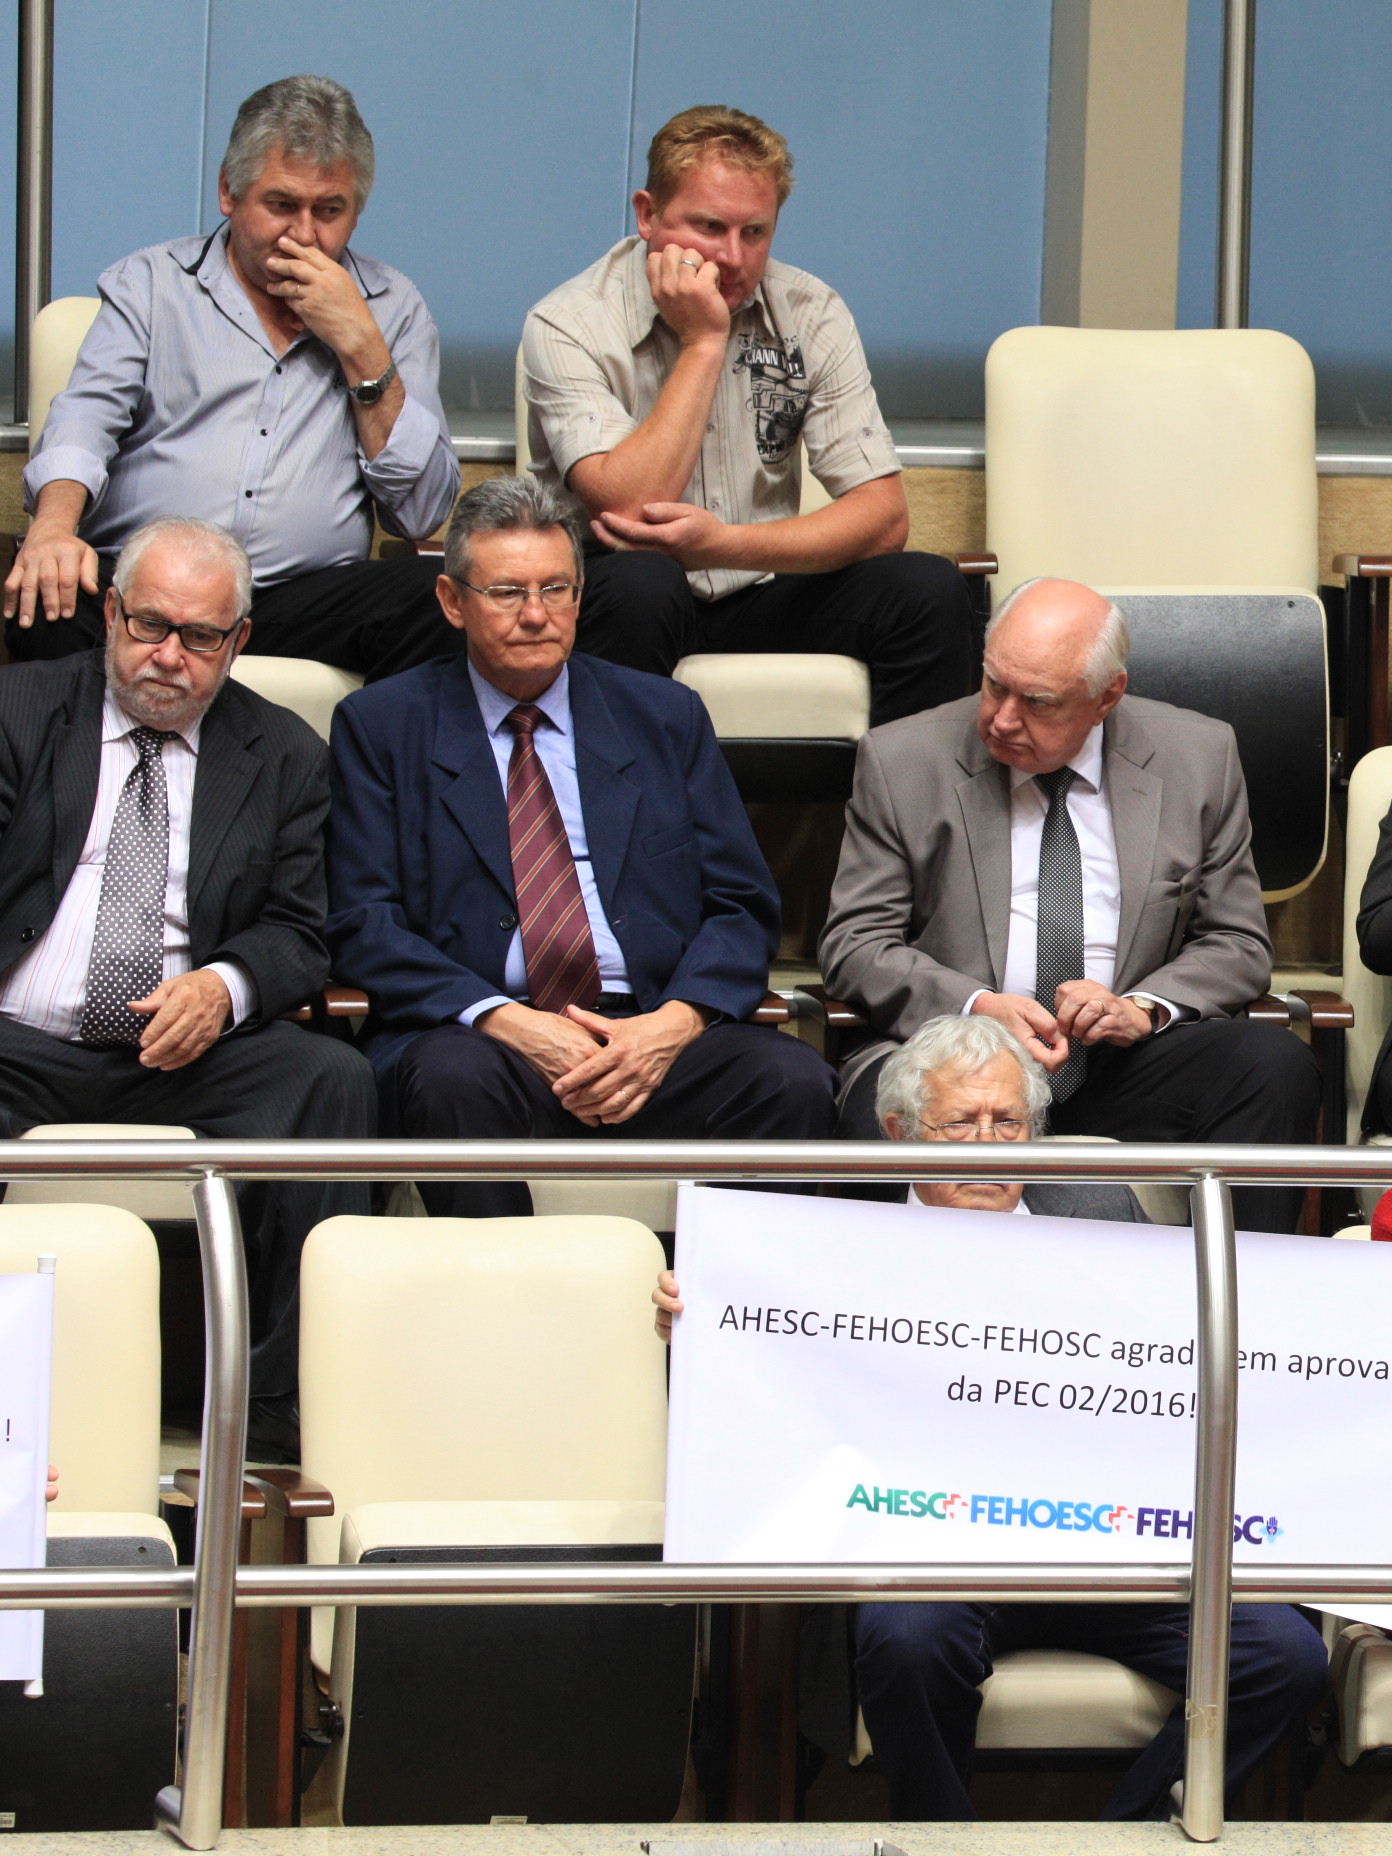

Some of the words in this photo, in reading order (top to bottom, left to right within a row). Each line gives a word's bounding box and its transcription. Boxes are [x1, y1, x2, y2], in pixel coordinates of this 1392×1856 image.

[718, 1304, 1102, 1359] AHESC-FEHOESC-FEHOSC
[1110, 1338, 1278, 1372] agradem
[947, 1374, 983, 1403] da
[994, 1379, 1051, 1408] PEC
[1059, 1384, 1196, 1419] 02/2016!
[846, 1483, 948, 1520] AHESC
[970, 1494, 1114, 1534] FEHOESC
[1136, 1507, 1264, 1545] FEHSC
